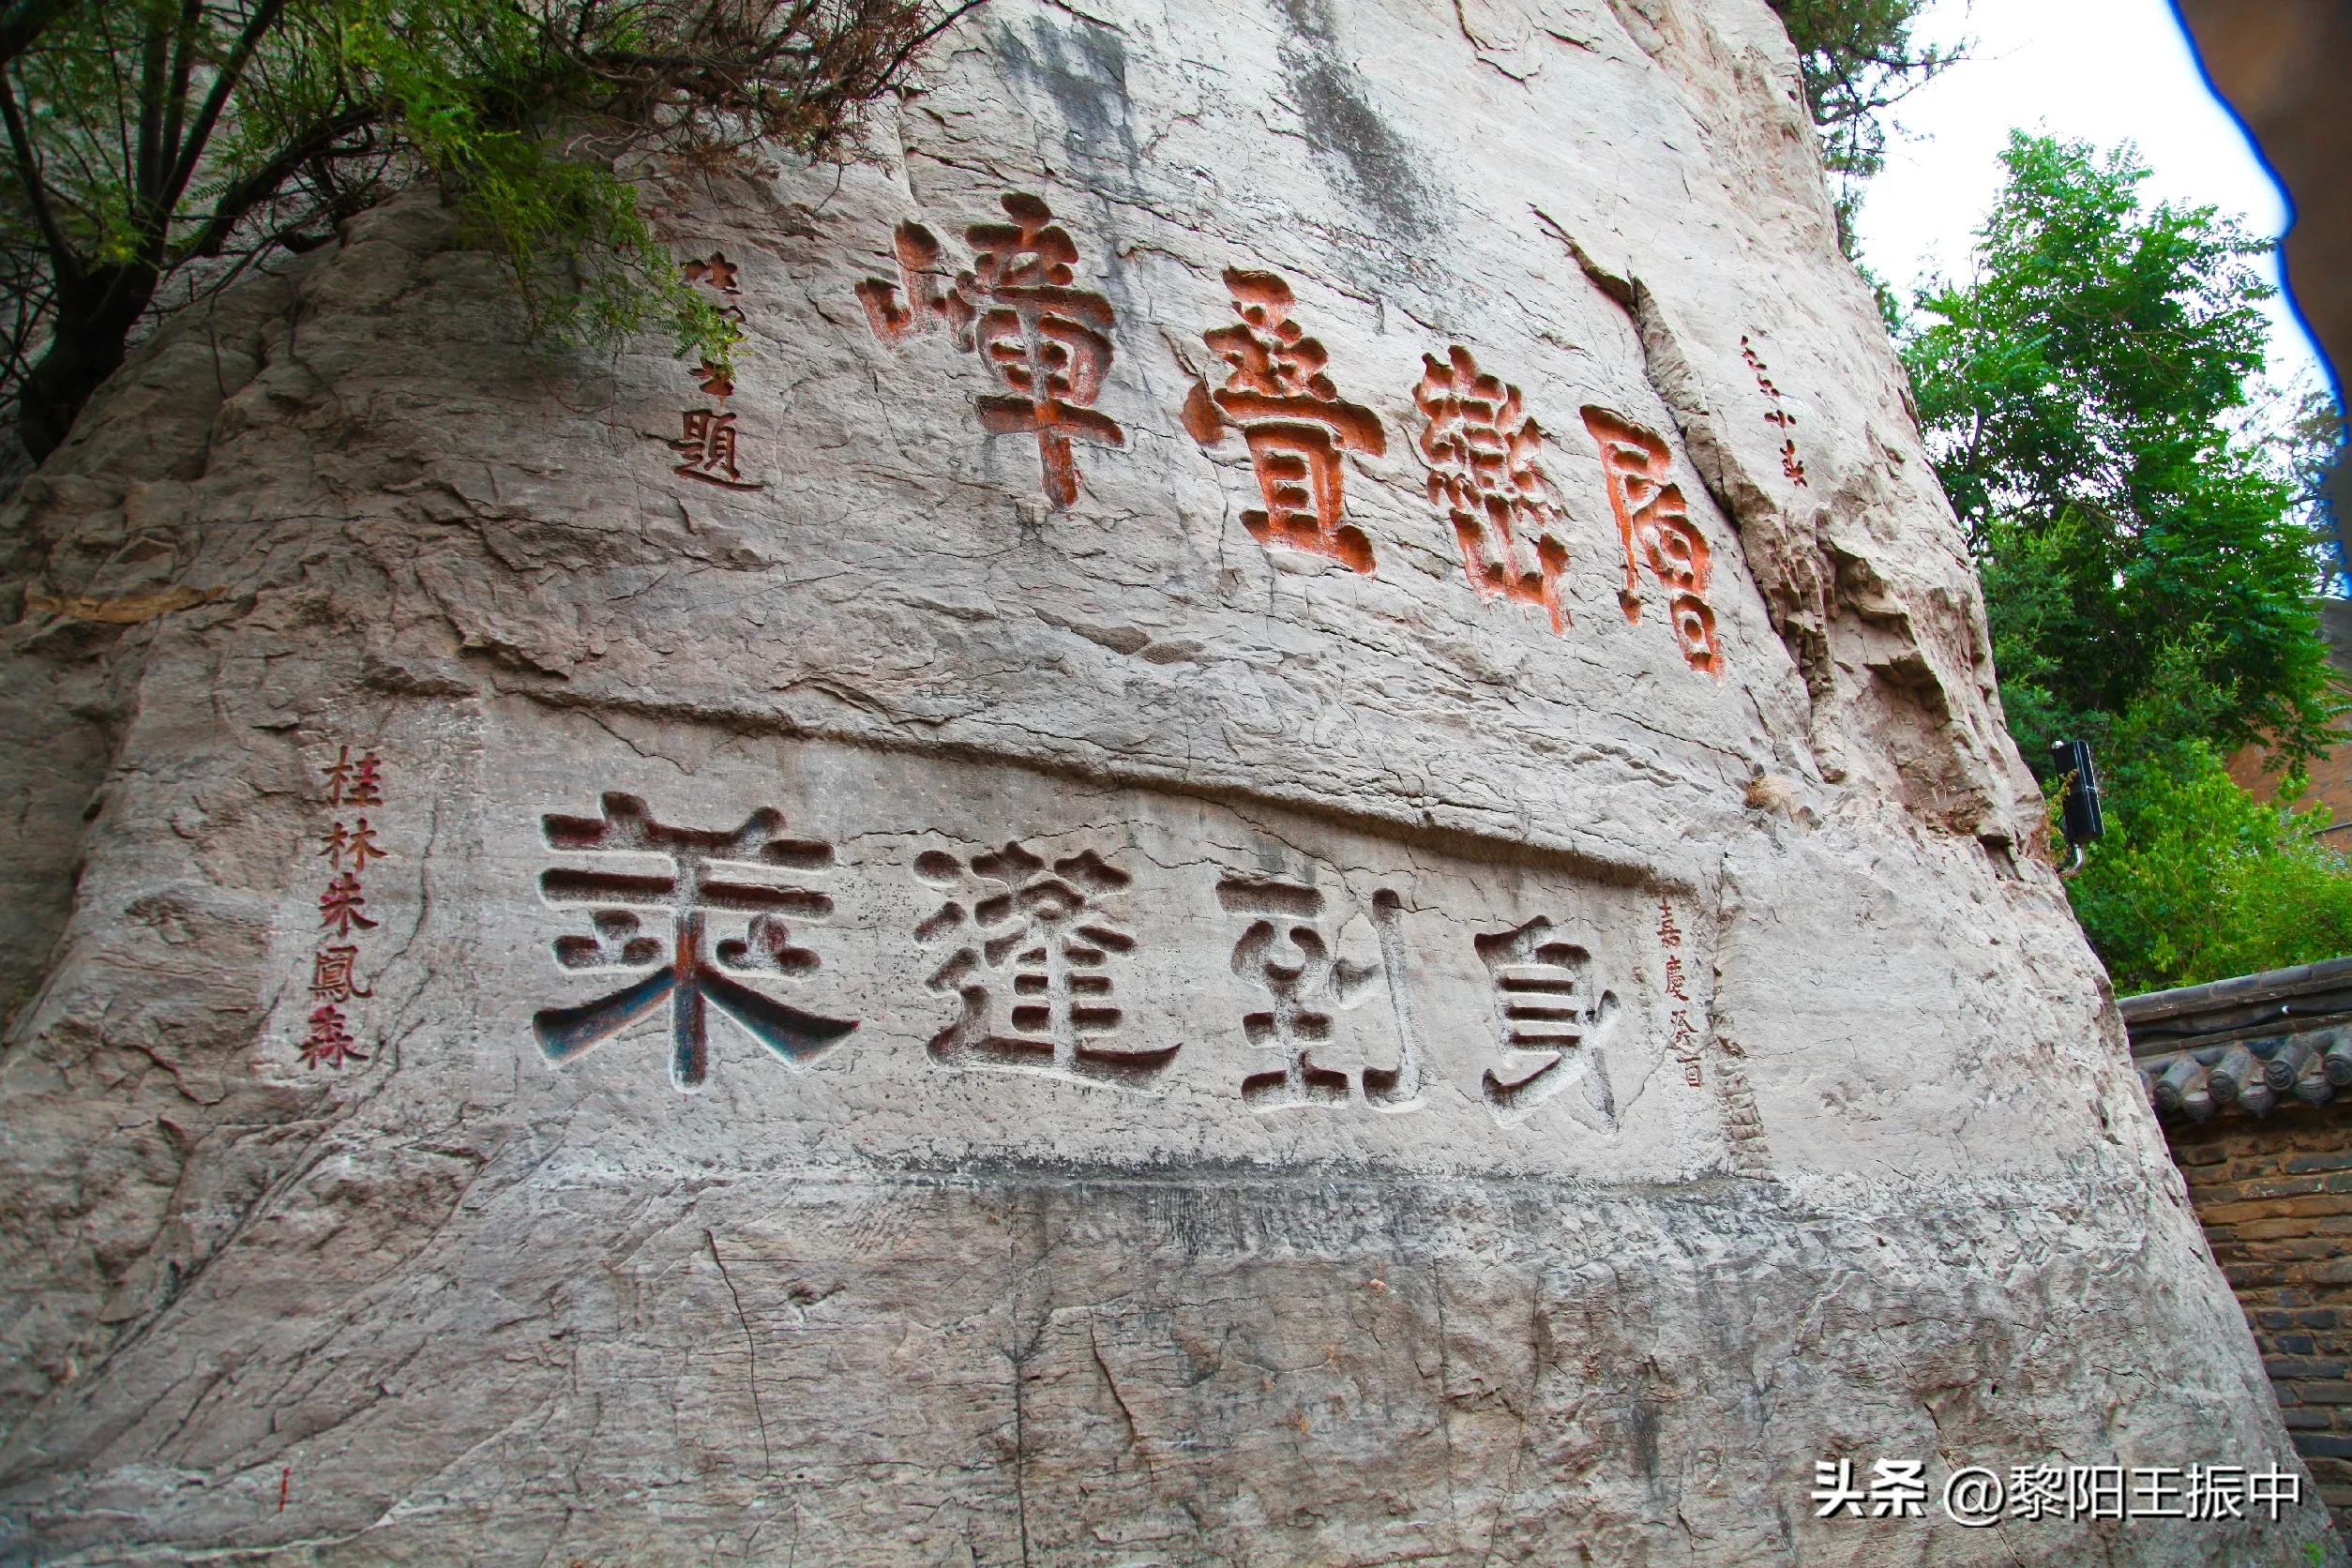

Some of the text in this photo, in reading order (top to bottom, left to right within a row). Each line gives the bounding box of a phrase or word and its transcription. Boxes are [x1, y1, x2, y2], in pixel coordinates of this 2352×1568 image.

[294, 745, 387, 1071] 桂林朱鳳森
